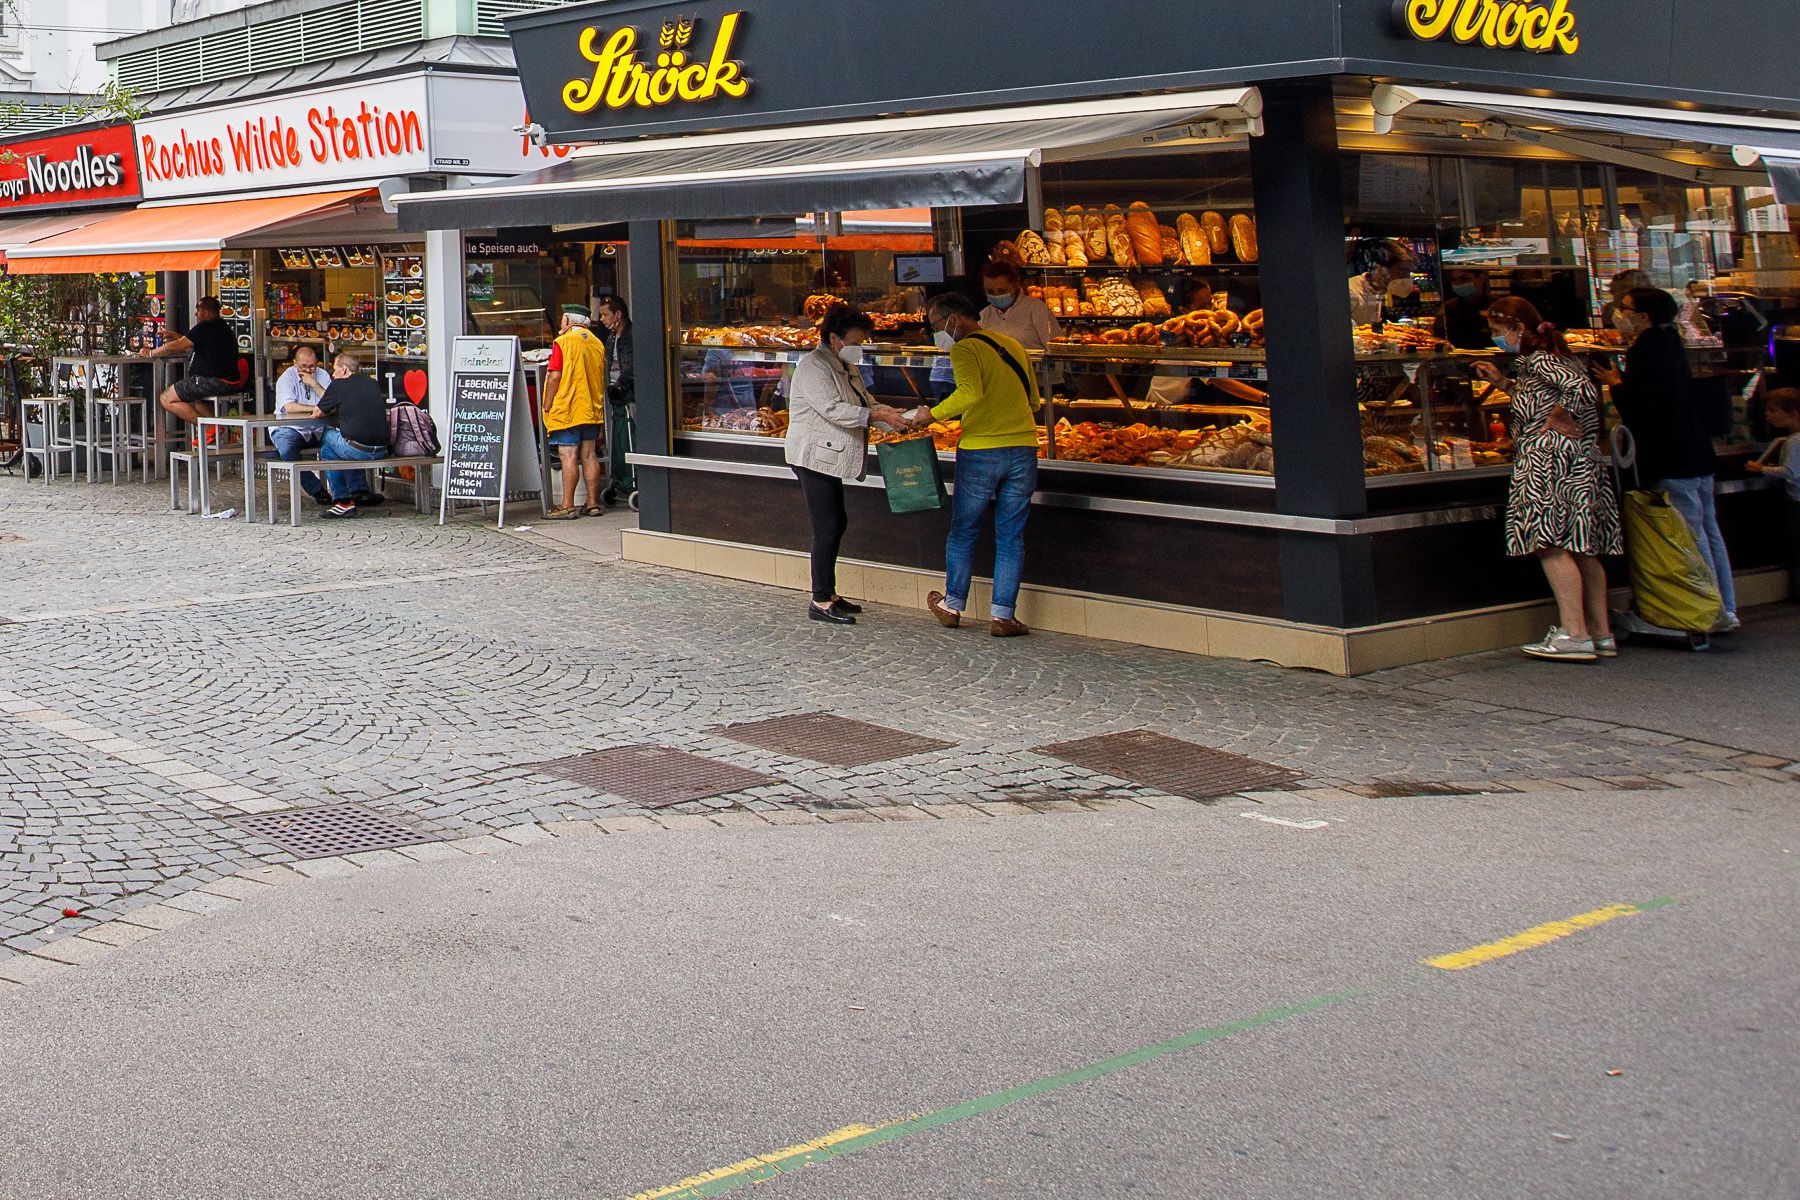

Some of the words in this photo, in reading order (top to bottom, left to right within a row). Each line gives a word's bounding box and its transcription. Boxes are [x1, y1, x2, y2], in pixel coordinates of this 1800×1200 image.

[562, 11, 749, 113] Ströck
[141, 134, 224, 183] Rochus
[227, 116, 301, 171] Wilde
[307, 100, 425, 164] Station
[27, 145, 119, 194] Noodles
[465, 243, 477, 253] lle
[479, 242, 515, 255] Speisen
[517, 243, 539, 253] auch
[460, 357, 504, 367] Heineken
[458, 378, 508, 391] LEBERKÄSE
[461, 390, 506, 401] SEMMELN
[454, 423, 486, 433] PFERD
[452, 443, 489, 453] SCHWEIN
[451, 459, 495, 470] SCHNITZEL
[459, 469, 495, 479] SEMMEL
[450, 478, 482, 487] HIRSCH
[449, 486, 476, 495] HUHN
